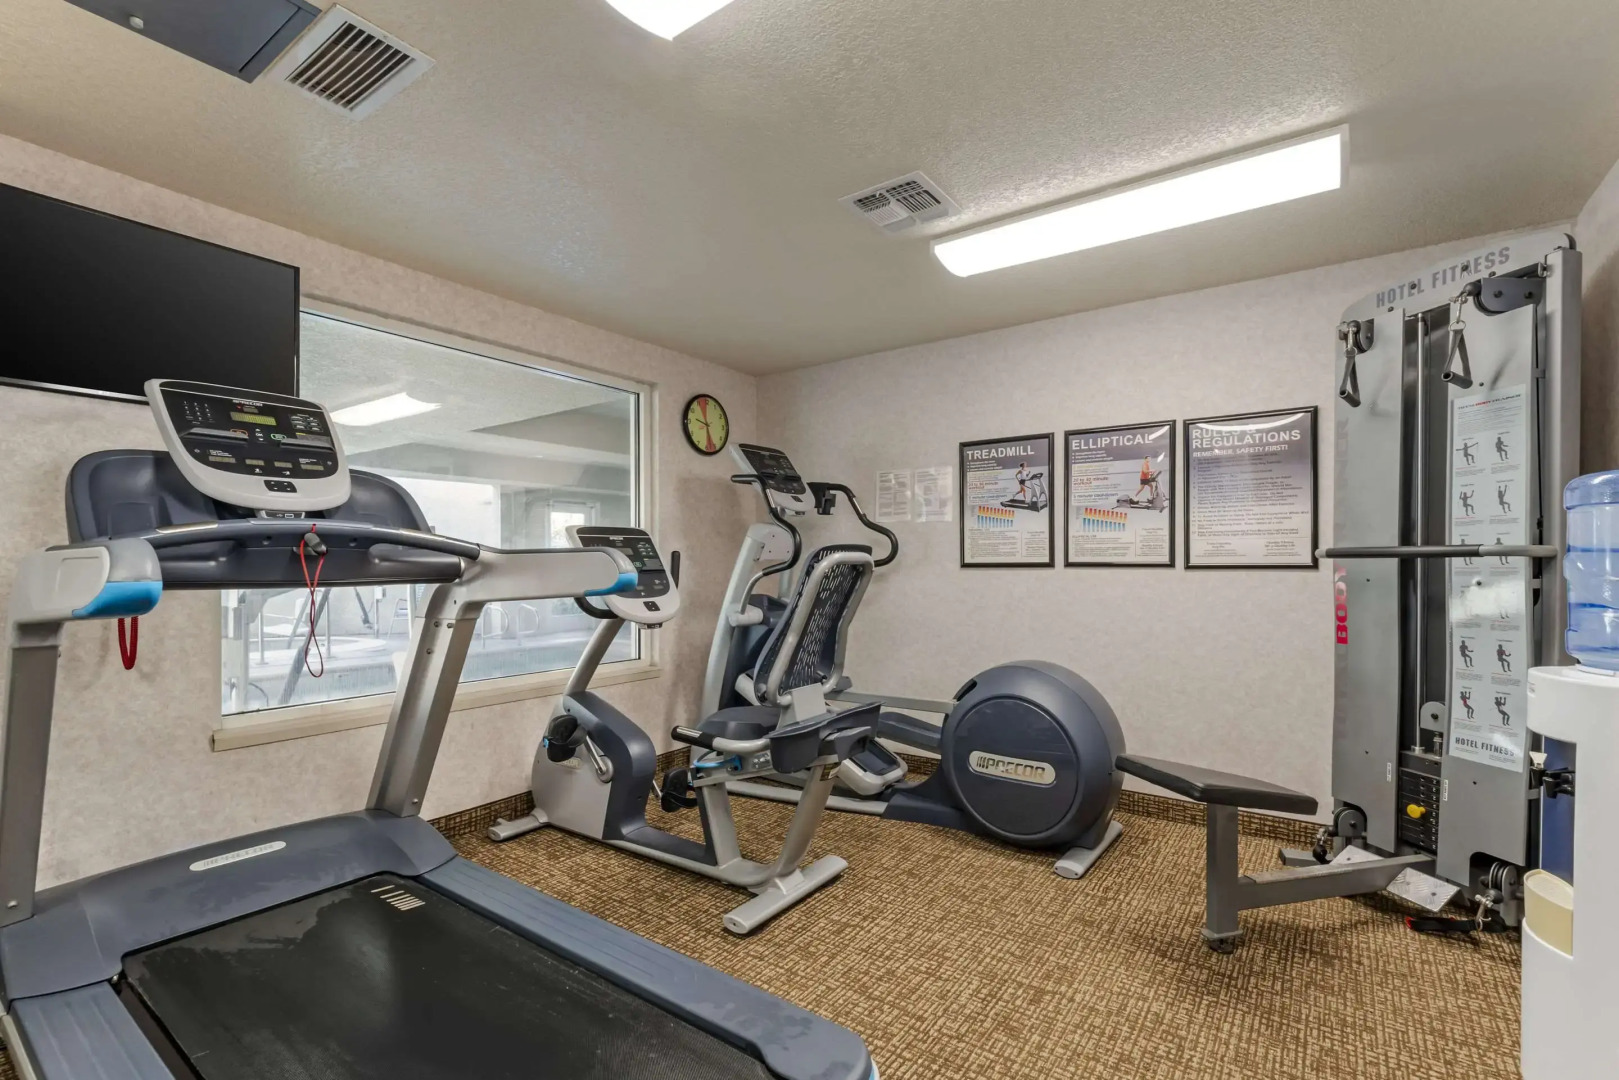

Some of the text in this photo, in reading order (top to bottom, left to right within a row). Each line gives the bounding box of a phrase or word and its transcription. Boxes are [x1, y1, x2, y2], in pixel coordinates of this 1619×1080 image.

[1376, 246, 1510, 308] HOTEL FITNESS
[1072, 433, 1153, 450] ELLIPTICAL
[1192, 430, 1301, 449] REGULATIONS
[967, 445, 1035, 460] TREADMILL
[1236, 446, 1263, 454] SAFETY
[1455, 737, 1479, 748] HOTEL
[1481, 742, 1515, 756] FITNESS
